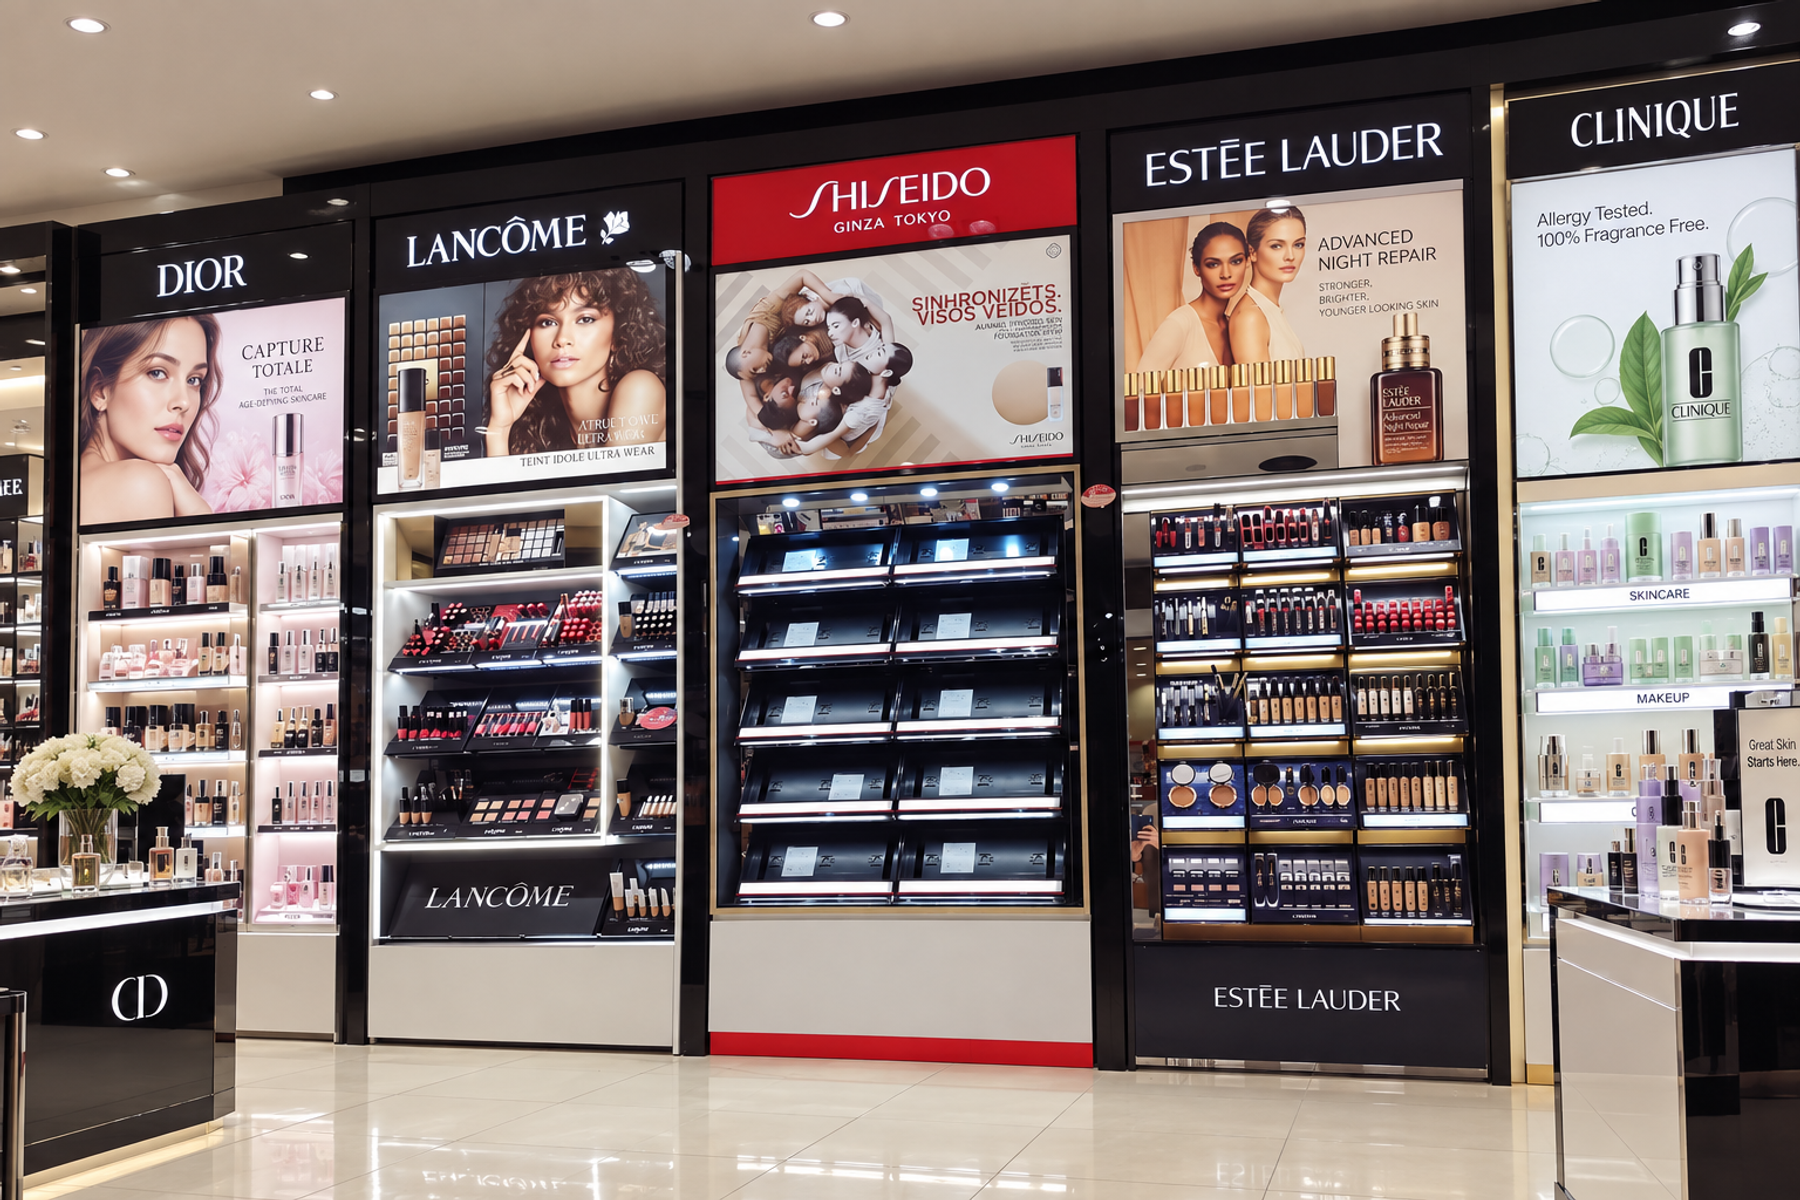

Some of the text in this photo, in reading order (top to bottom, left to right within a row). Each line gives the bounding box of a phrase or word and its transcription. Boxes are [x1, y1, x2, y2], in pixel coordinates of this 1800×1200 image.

[1570, 93, 1739, 148] CLINIQUE
[1281, 121, 1444, 174] LAUDER
[789, 167, 991, 219] SHISEIDO
[834, 210, 951, 234] GINZA TOKYO
[1537, 201, 1653, 228] Allergy Tested.
[406, 214, 587, 268] LANCÔME
[1318, 229, 1413, 252] ADVANCED
[1537, 218, 1709, 248] 100% Fragrance Free.
[1319, 247, 1437, 271] NIGHT REPAIR
[156, 254, 247, 297] DIOR
[917, 305, 976, 326] VISOS
[982, 298, 1062, 320] VEIDOS.
[1319, 299, 1439, 318] YOUNGER LOOKING SKIN
[241, 336, 325, 361] CAPTURE
[252, 358, 313, 379] TOTALE
[264, 385, 303, 396] THE TOTAL
[1671, 401, 1731, 419] CLINIQUE
[520, 446, 655, 467] TEINT IDOLE ULTRA WEAR
[0, 478, 23, 496] EE
[1629, 588, 1690, 602] SKINCARE
[1636, 692, 1690, 704] MAKEUP
[1749, 738, 1797, 751] Great Skin
[1747, 755, 1800, 768] Starts Here.
[425, 881, 574, 910] LANCÔME
[1297, 988, 1402, 1012] LAUDER
